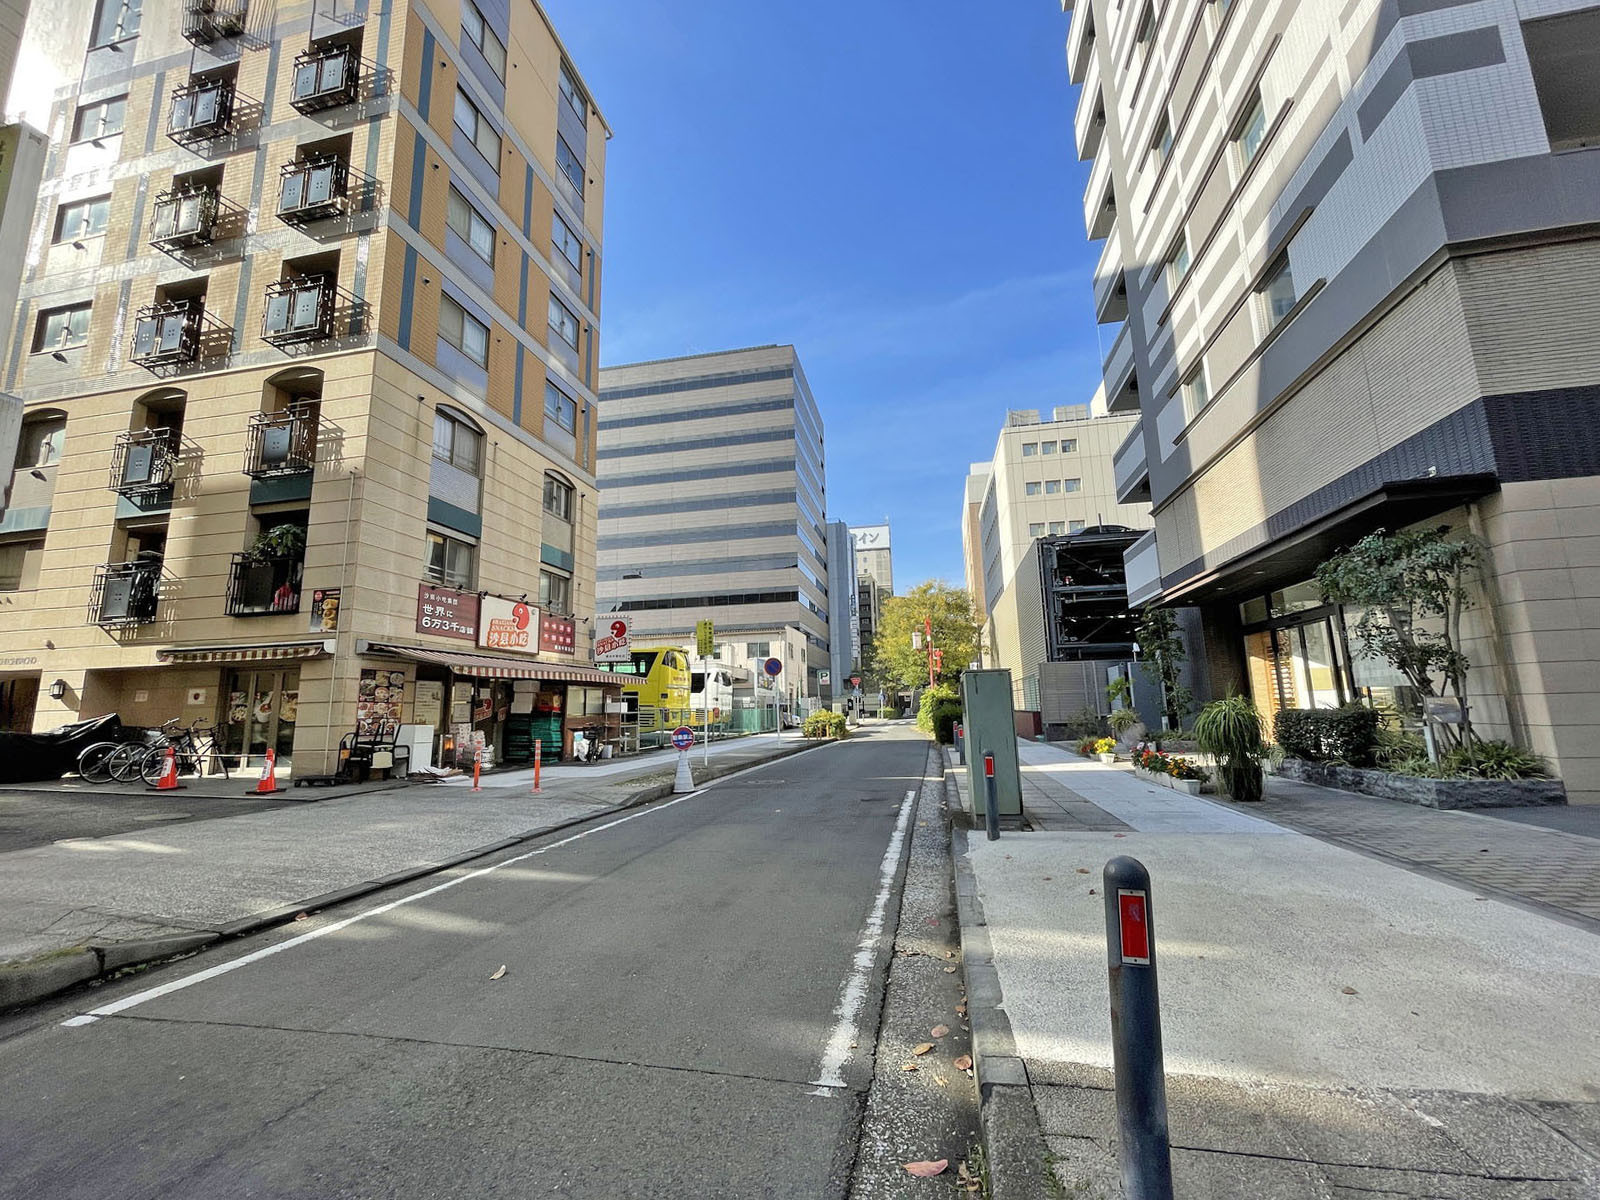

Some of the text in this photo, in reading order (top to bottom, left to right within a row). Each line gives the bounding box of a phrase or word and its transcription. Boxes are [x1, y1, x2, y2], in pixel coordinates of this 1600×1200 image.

[422, 603, 454, 618] 世界に
[820, 672, 828, 680] P
